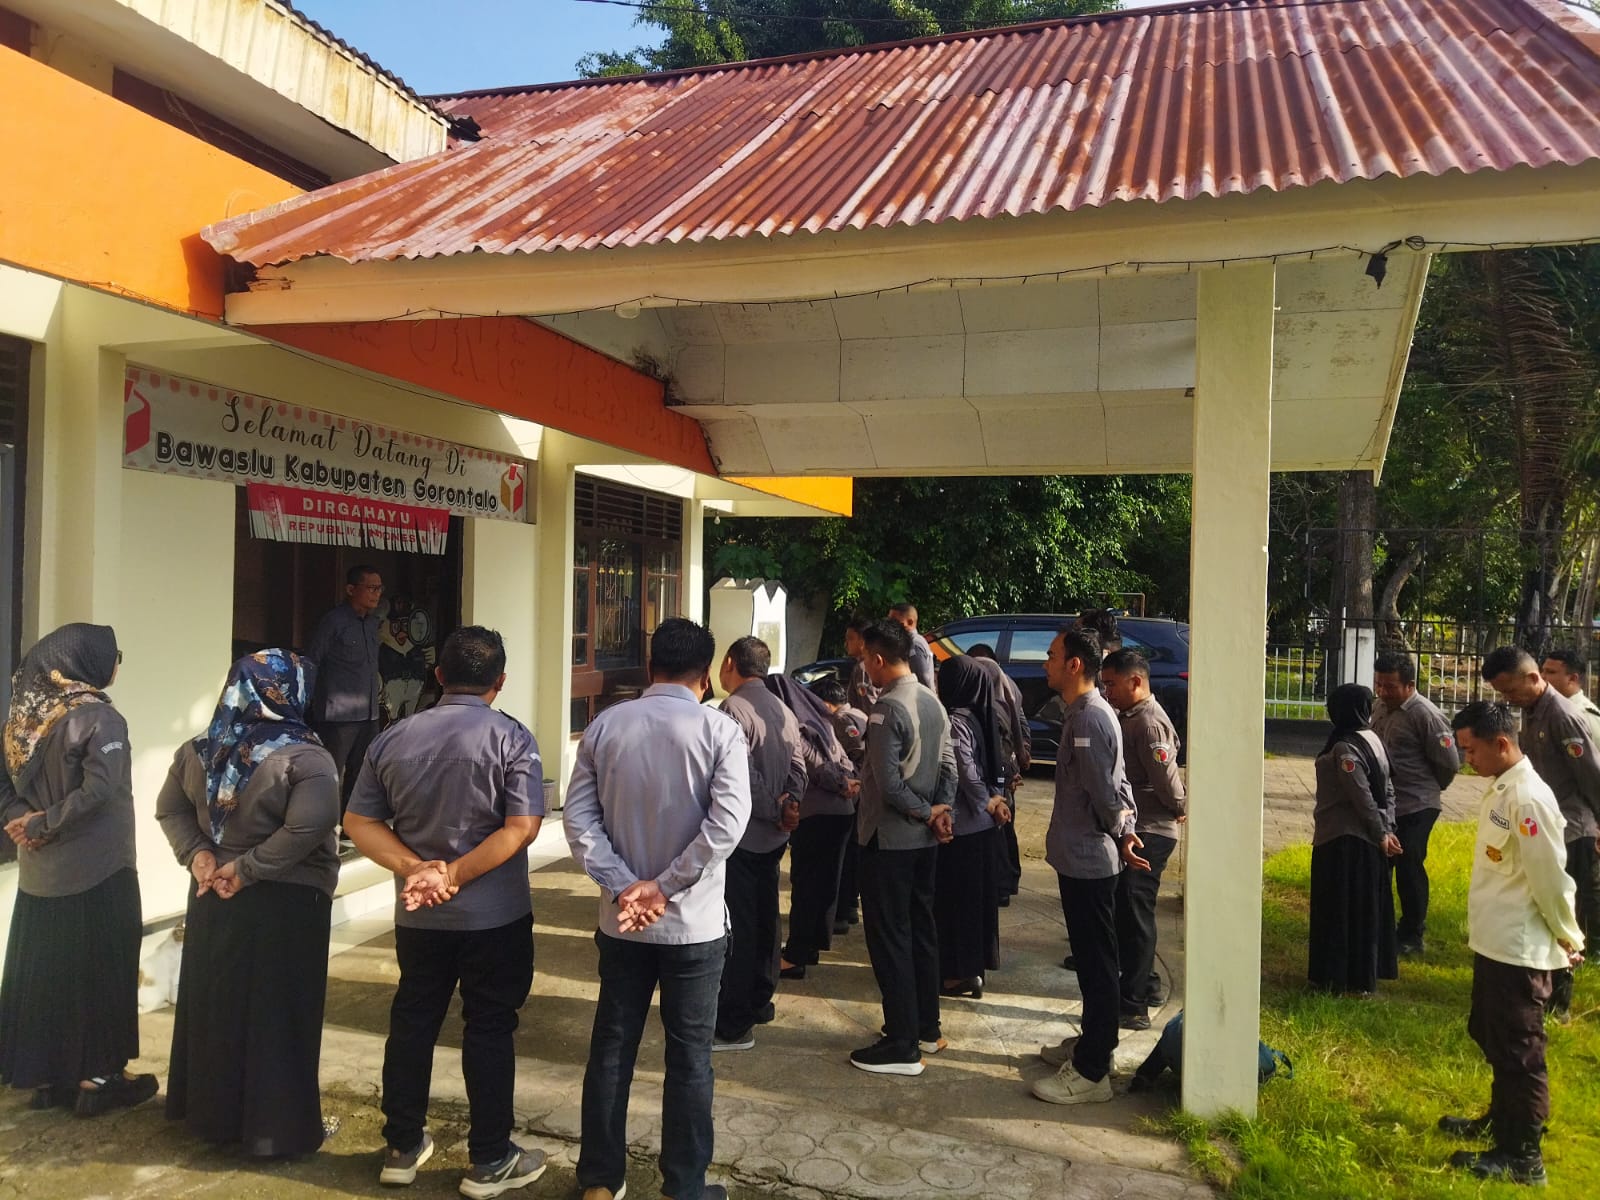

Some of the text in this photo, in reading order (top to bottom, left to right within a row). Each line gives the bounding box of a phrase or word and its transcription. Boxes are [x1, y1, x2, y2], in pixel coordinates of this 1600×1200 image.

[221, 395, 467, 479] Selamat Datang Di
[155, 431, 499, 512] Bawaslu Kabupaten Gorontalo
[289, 520, 356, 537] REPUBLIK
[302, 497, 411, 525] DIRGAHAYU
